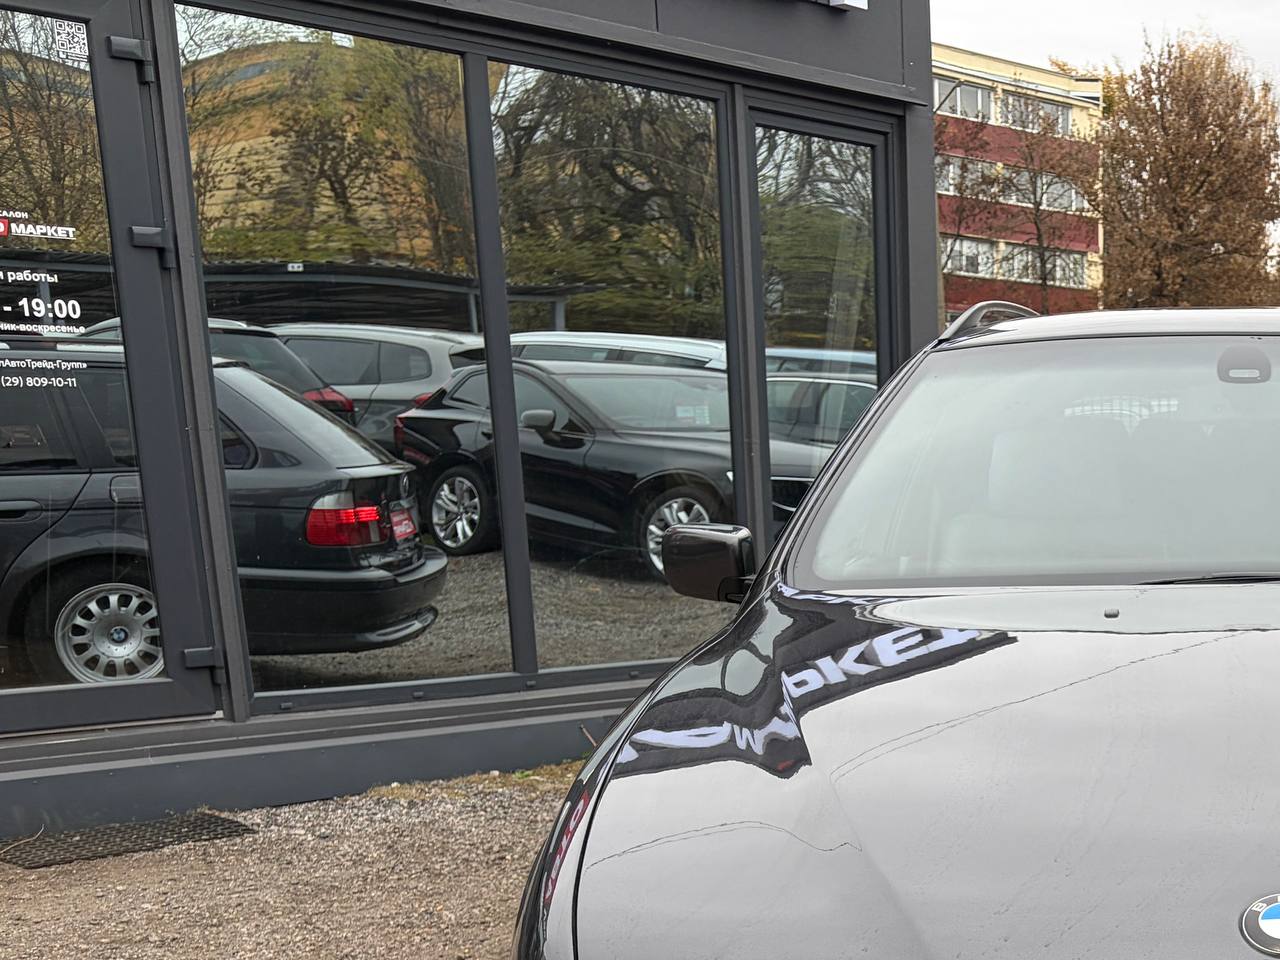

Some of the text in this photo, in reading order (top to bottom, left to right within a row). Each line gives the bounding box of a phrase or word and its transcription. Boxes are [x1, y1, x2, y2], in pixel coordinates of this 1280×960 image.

[0, 210, 28, 219] АЛОН
[10, 222, 76, 238] МАРКЕТ
[7, 270, 59, 283] работы
[18, 297, 81, 319] 19:00
[1, 375, 77, 388] (29) 809-10-11
